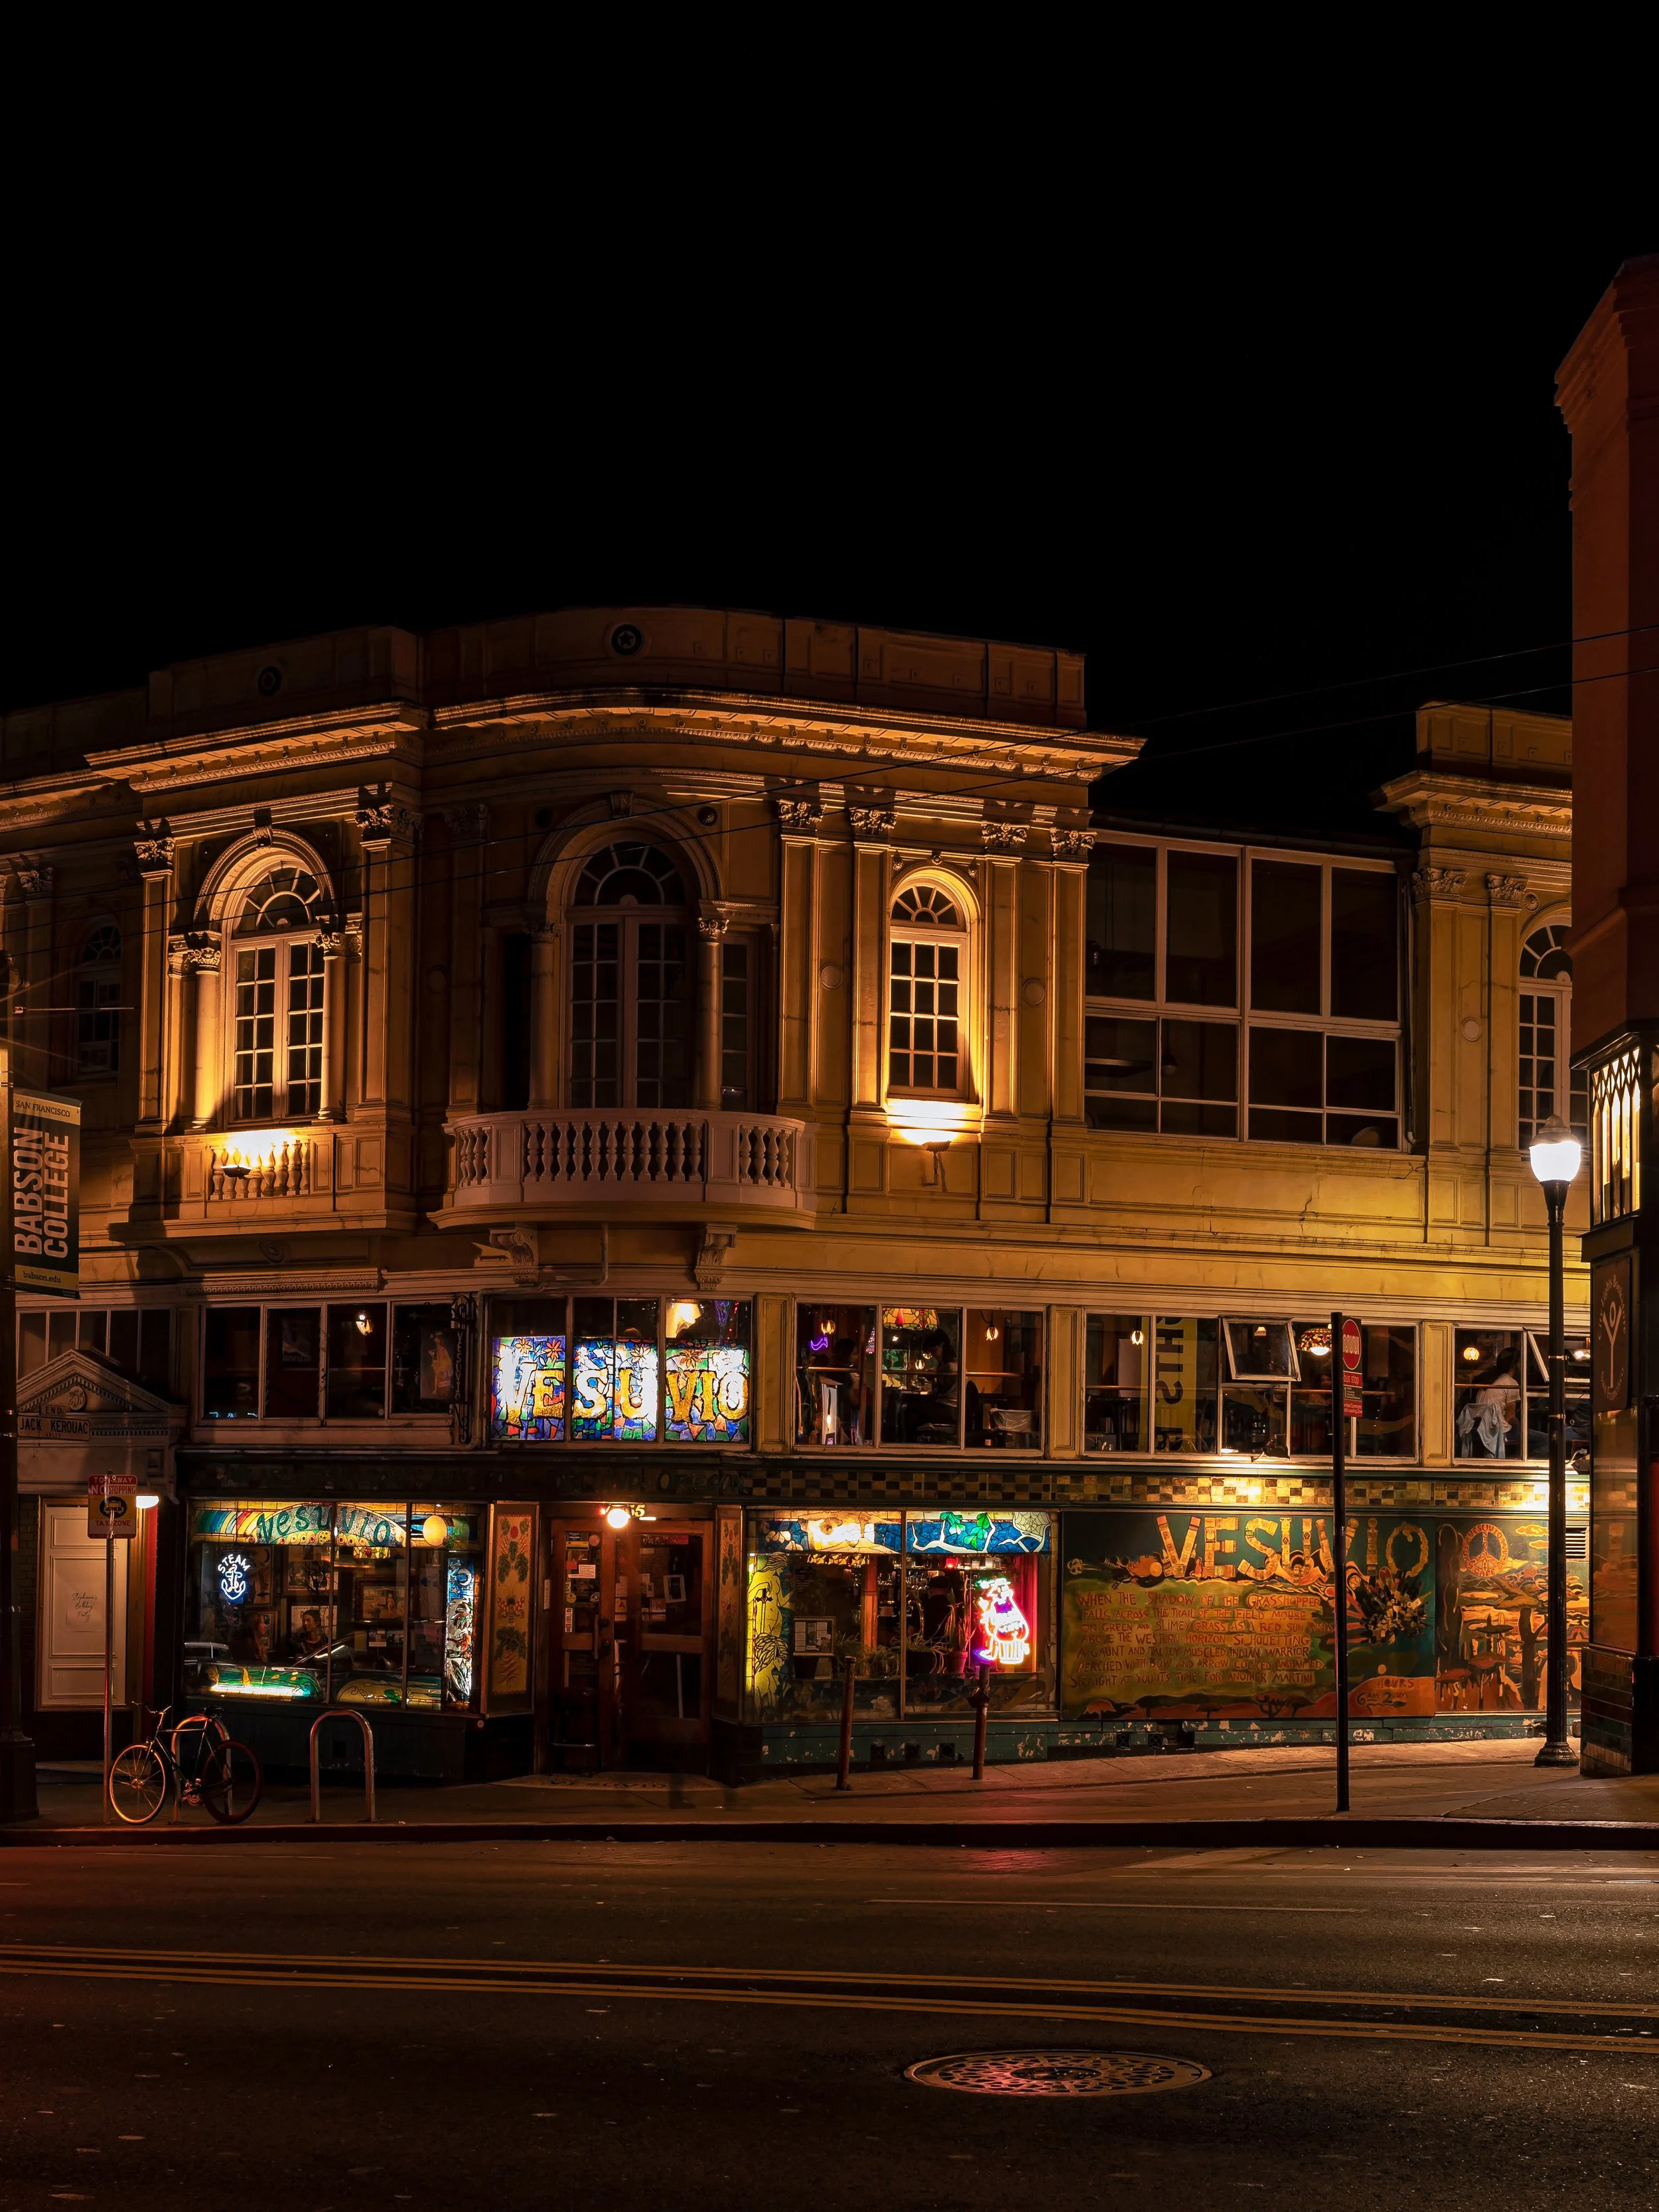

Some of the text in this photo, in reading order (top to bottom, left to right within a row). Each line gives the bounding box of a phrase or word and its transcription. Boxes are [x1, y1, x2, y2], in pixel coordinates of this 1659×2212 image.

[15, 1100, 70, 1118] SAN FRANCISCO
[13, 1127, 43, 1255] BABSON
[44, 1132, 69, 1258] COLLEGE
[23, 1270, 61, 1283] babson.edu
[500, 1347, 749, 1430] VESUVIO
[46, 1406, 62, 1415] END
[20, 1418, 88, 1434] JACK KEROUAC
[109, 1486, 135, 1494] STOPPING
[1155, 1515, 1429, 1584] VESUVIO
[218, 1554, 251, 1574] STEAM
[1077, 1592, 1321, 1608] WHEN THE SHADOW OF THE GRASSHOPPER
[1083, 1608, 1111, 1620] FALLS
[1115, 1608, 1149, 1620] ACROSS
[1153, 1608, 1169, 1618] THE
[1171, 1608, 1196, 1618] TRAIL
[1198, 1608, 1210, 1618] OF
[1214, 1609, 1230, 1618] THE
[1271, 1610, 1307, 1621] MOUSE
[1080, 1624, 1097, 1632] ON
[1102, 1623, 1133, 1632] GREEN
[1194, 1621, 1226, 1632] GRASS
[1231, 1622, 1244, 1631] AS
[1260, 1622, 1281, 1632] RED
[1287, 1623, 1303, 1632] SUN
[1081, 1634, 1114, 1644] ABOVE
[1118, 1632, 1132, 1643] THE
[1135, 1634, 1180, 1645] WESTERN
[1077, 1648, 1086, 1658] A
[1091, 1645, 1125, 1657] GAUNT
[1128, 1647, 1145, 1656] AND
[1184, 1647, 1226, 1657] MUSCLED
[1264, 1647, 1309, 1657] WARRIOR
[1076, 1660, 1122, 1673] PERCHED
[1125, 1659, 1146, 1669] WITH
[1149, 1659, 1172, 1668] BOW
[1176, 1659, 1193, 1668] AND
[1196, 1659, 1228, 1668] ARROW
[1234, 1660, 1271, 1671] COCKED
[1120, 1675, 1131, 1684] AT
[1136, 1674, 1153, 1684] YOU
[1204, 1672, 1222, 1682] FOR
[1228, 1671, 1267, 1683] ANOTHER
[1378, 1679, 1414, 1688] HOURS
